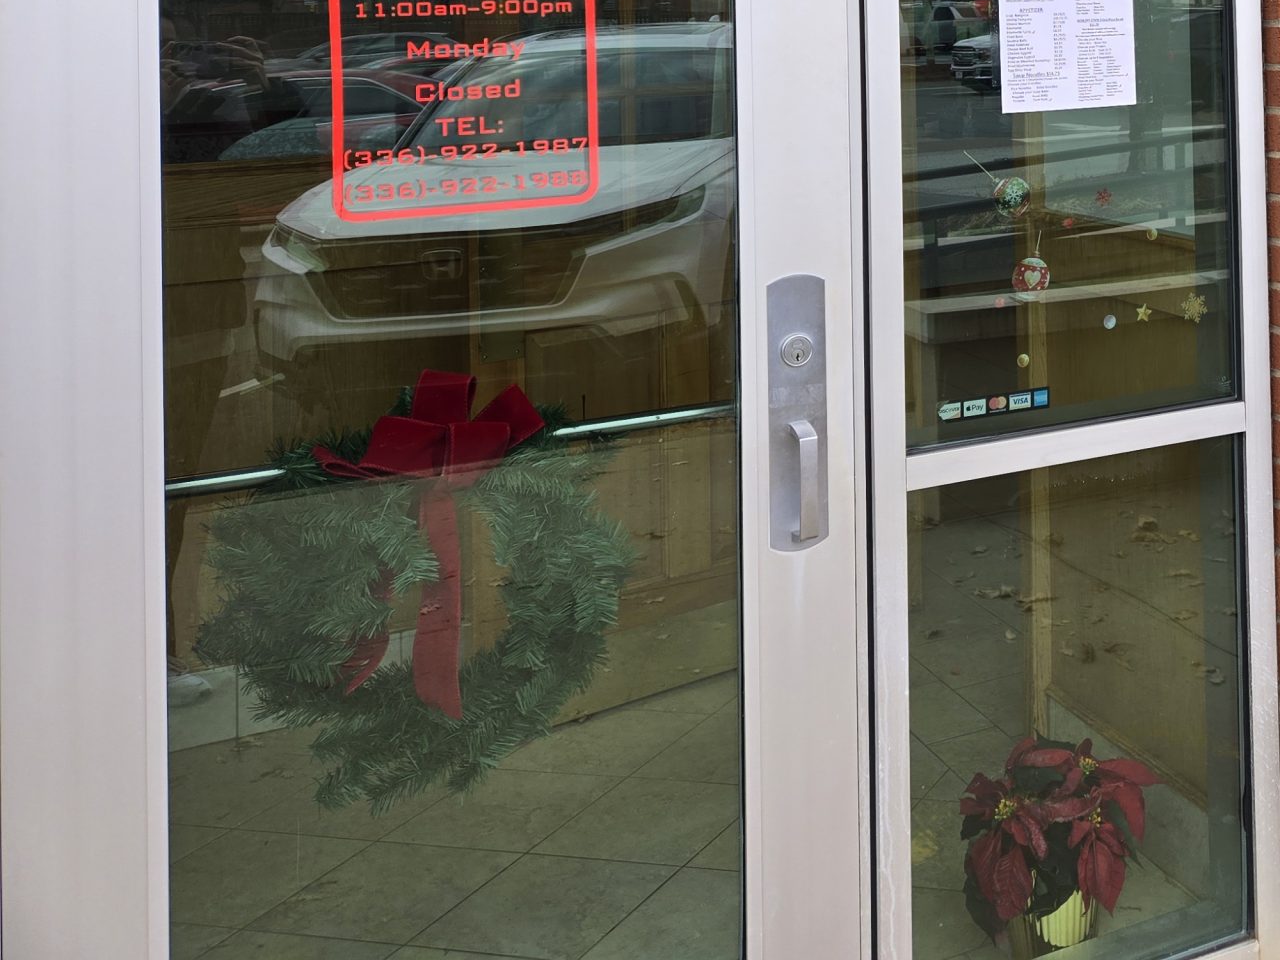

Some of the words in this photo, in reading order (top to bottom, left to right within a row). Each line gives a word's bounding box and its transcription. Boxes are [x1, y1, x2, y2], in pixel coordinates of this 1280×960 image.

[406, 37, 526, 61] Monday
[415, 79, 521, 102] Closed
[434, 115, 504, 137] TEL:
[343, 137, 588, 171] (336)-922-1987
[971, 403, 984, 412] Pay
[1013, 397, 1029, 406] VISA
